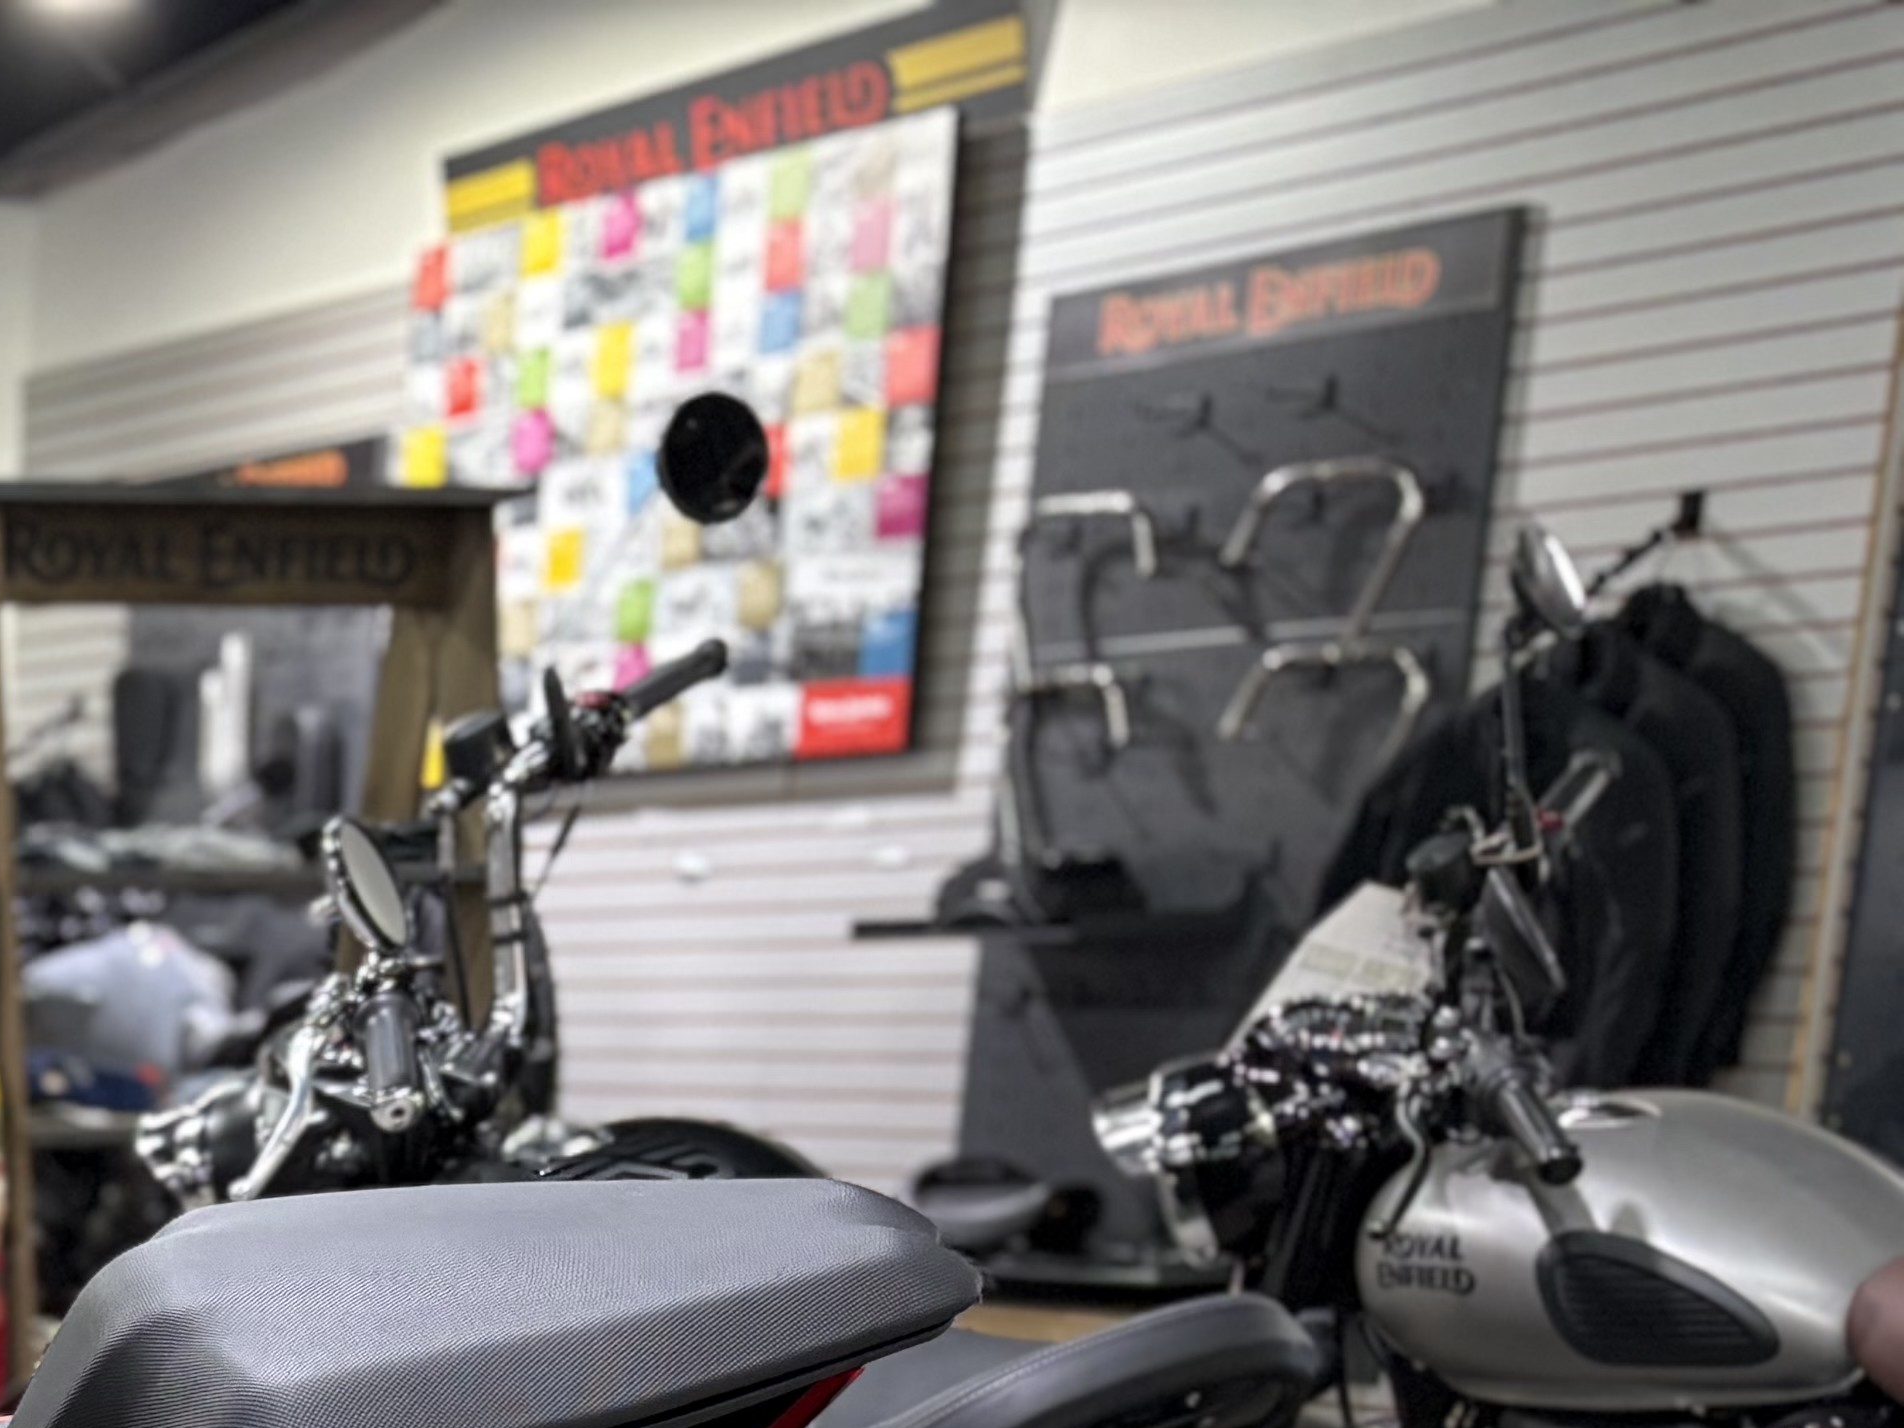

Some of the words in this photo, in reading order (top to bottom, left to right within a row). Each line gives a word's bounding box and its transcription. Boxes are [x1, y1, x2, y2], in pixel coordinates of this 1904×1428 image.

[536, 122, 681, 206] ROYAL
[687, 60, 890, 170] ENFIELD
[1098, 281, 1237, 354] ROYAL
[1245, 248, 1441, 339] ENFIELD
[6, 519, 188, 584] ROYAL
[201, 519, 412, 589] ENFIELD
